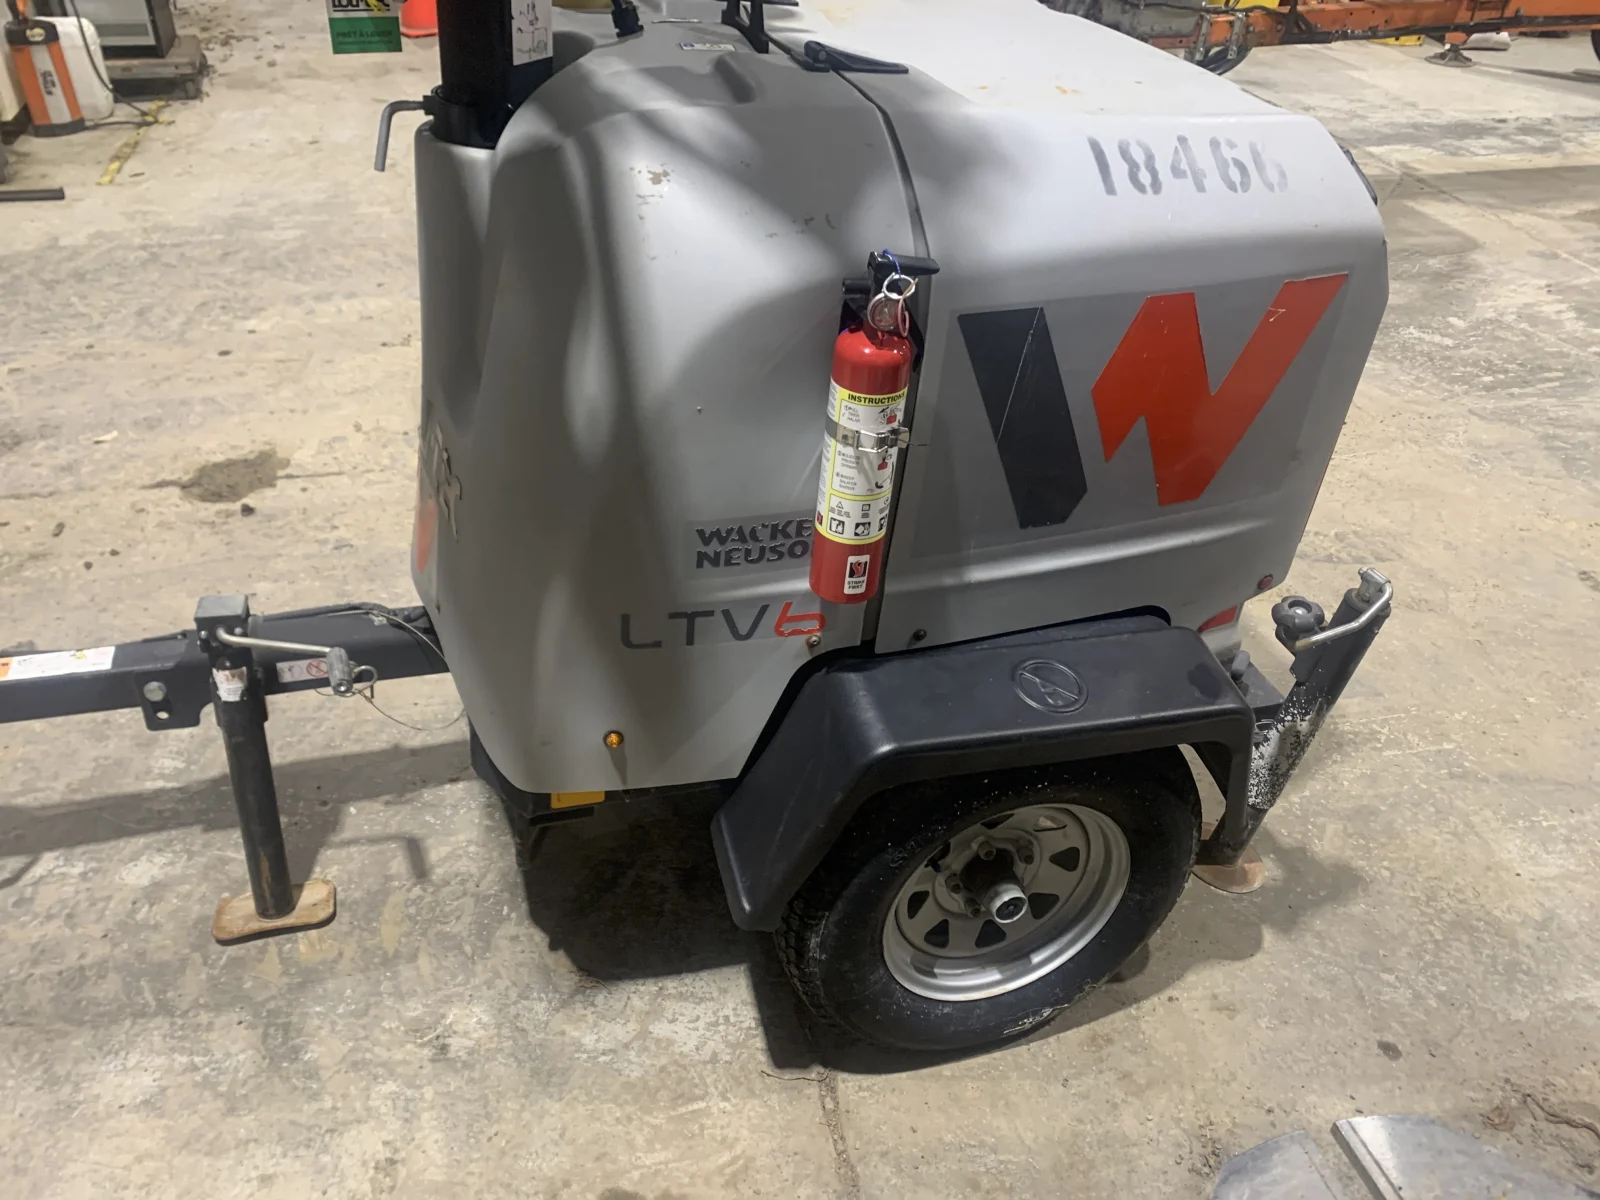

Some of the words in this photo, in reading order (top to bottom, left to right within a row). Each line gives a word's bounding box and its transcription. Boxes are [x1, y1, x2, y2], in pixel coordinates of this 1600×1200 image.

[1086, 134, 1288, 196] 18466
[847, 391, 906, 405] INSTRUCTIONS
[695, 518, 813, 547] WACKE
[695, 539, 811, 569] NEUSO
[620, 601, 826, 649] LTV6
